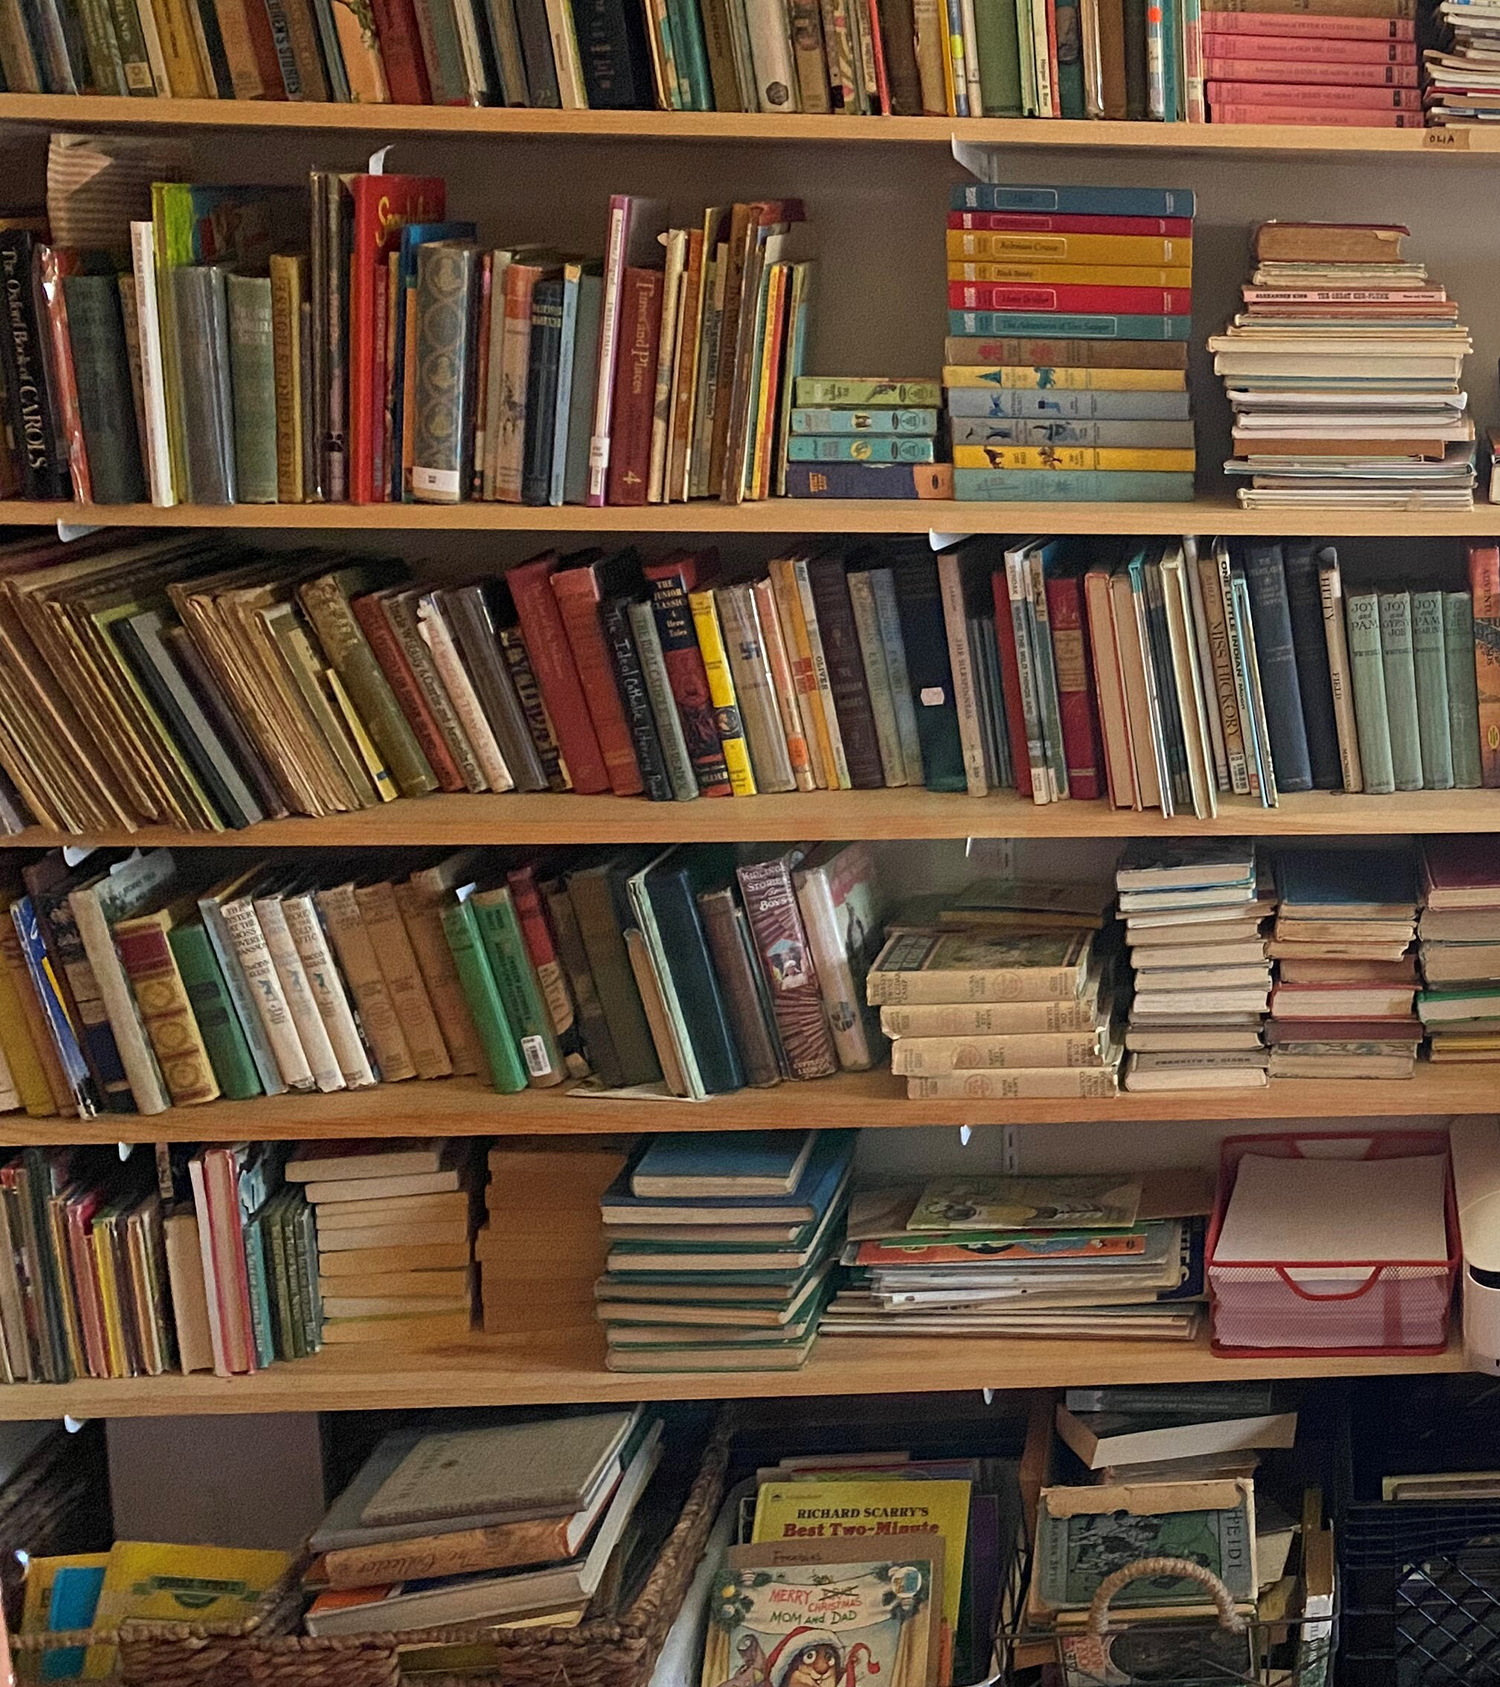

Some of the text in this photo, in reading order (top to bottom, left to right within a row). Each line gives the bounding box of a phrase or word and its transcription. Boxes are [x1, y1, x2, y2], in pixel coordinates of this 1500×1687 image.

[278, 47, 304, 95] STORIES
[635, 280, 655, 323] Times
[713, 310, 722, 332] Who
[635, 324, 651, 349] and
[710, 331, 720, 354] goes
[2, 247, 49, 470] The Oxford Book of CAROLS
[630, 349, 649, 396] Places
[706, 383, 717, 421] Lincoln?
[622, 470, 643, 486] 4
[656, 579, 673, 589] THE
[1008, 564, 1019, 596] SENDAK
[653, 588, 682, 601] JUNIOR
[1415, 599, 1438, 610] JOY
[1351, 602, 1376, 613] JOY
[1384, 601, 1406, 612] JOY
[635, 618, 649, 638] THE
[666, 620, 685, 629] Hero
[669, 629, 688, 638] Tales
[1350, 620, 1379, 632] PAM
[1414, 616, 1441, 628] PAM
[1221, 560, 1248, 711] ONE LITTLE INDIAN Moon
[1321, 576, 1335, 622] HITTY
[1332, 672, 1343, 700] FIELD
[640, 639, 656, 669] IDEAL
[954, 638, 965, 657] THE
[387, 599, 407, 628] Uncle
[401, 629, 424, 667] Wiggily
[419, 677, 440, 708] Charlie
[435, 708, 448, 723] and
[1012, 605, 1034, 716] WHERE THE WILD THINGS ARE
[814, 655, 829, 691] OLIVER
[1211, 621, 1241, 739] MISS HICKORY
[606, 607, 655, 772] The Ideal Catholic Literary
[1046, 1006, 1054, 1031] ISLAND
[797, 1506, 929, 1519] RICHARD SCARRY'S
[783, 1520, 940, 1538] Best Two-Minute
[1226, 1510, 1243, 1569] HEIDI
[357, 1550, 480, 1576] The Collector
[768, 1589, 813, 1605] MERRY
[807, 1597, 863, 1612] CHRISTMAS
[769, 1611, 803, 1624] MOM
[830, 1610, 858, 1625] DAD
